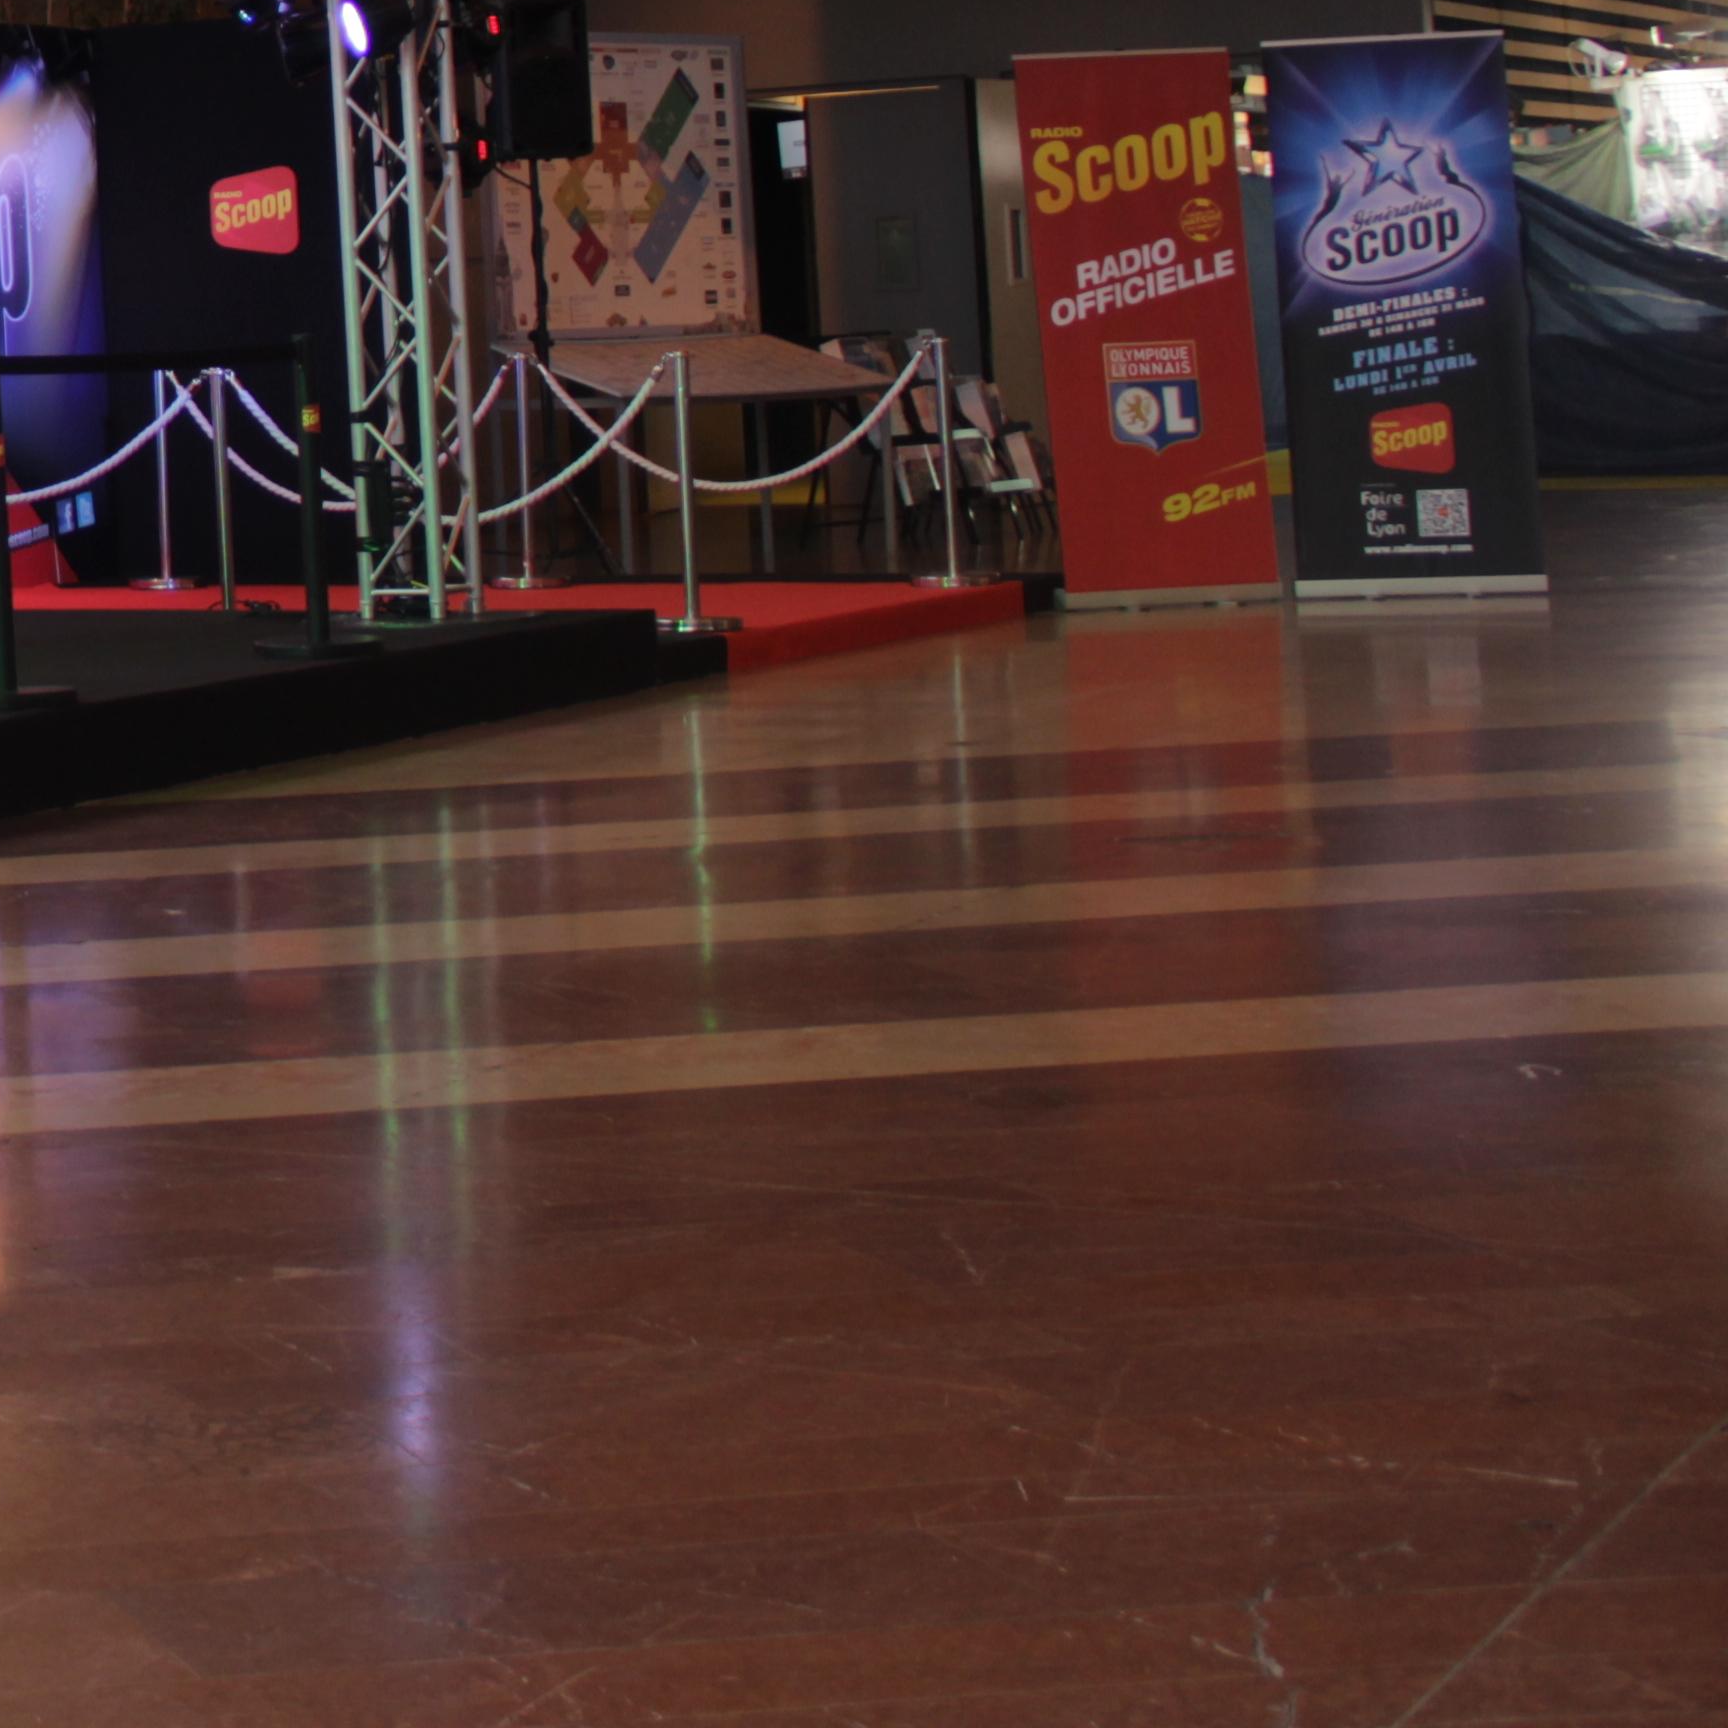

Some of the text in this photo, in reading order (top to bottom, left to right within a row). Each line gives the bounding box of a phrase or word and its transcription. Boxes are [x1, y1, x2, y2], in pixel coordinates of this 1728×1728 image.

[1029, 126, 1084, 139] RADIO
[1033, 111, 1227, 215] Scoop
[215, 188, 292, 233] Scoop
[1351, 196, 1444, 232] Génération
[1325, 208, 1460, 272] Scoop
[1076, 237, 1177, 289] RADIO
[1050, 248, 1235, 327] OFFICIELLE
[1333, 286, 1456, 322] DEMI-FINALES
[1109, 346, 1189, 363] OLYMPIQUE
[1111, 360, 1192, 378] LYONNAIS
[1352, 336, 1438, 369] FINALE
[1333, 369, 1389, 392] LUNDI
[1423, 353, 1478, 375] AVRIL
[1372, 420, 1448, 457] Scoop
[1360, 490, 1404, 506] Foire
[1365, 508, 1388, 521] de
[1366, 521, 1406, 538] Lyon
